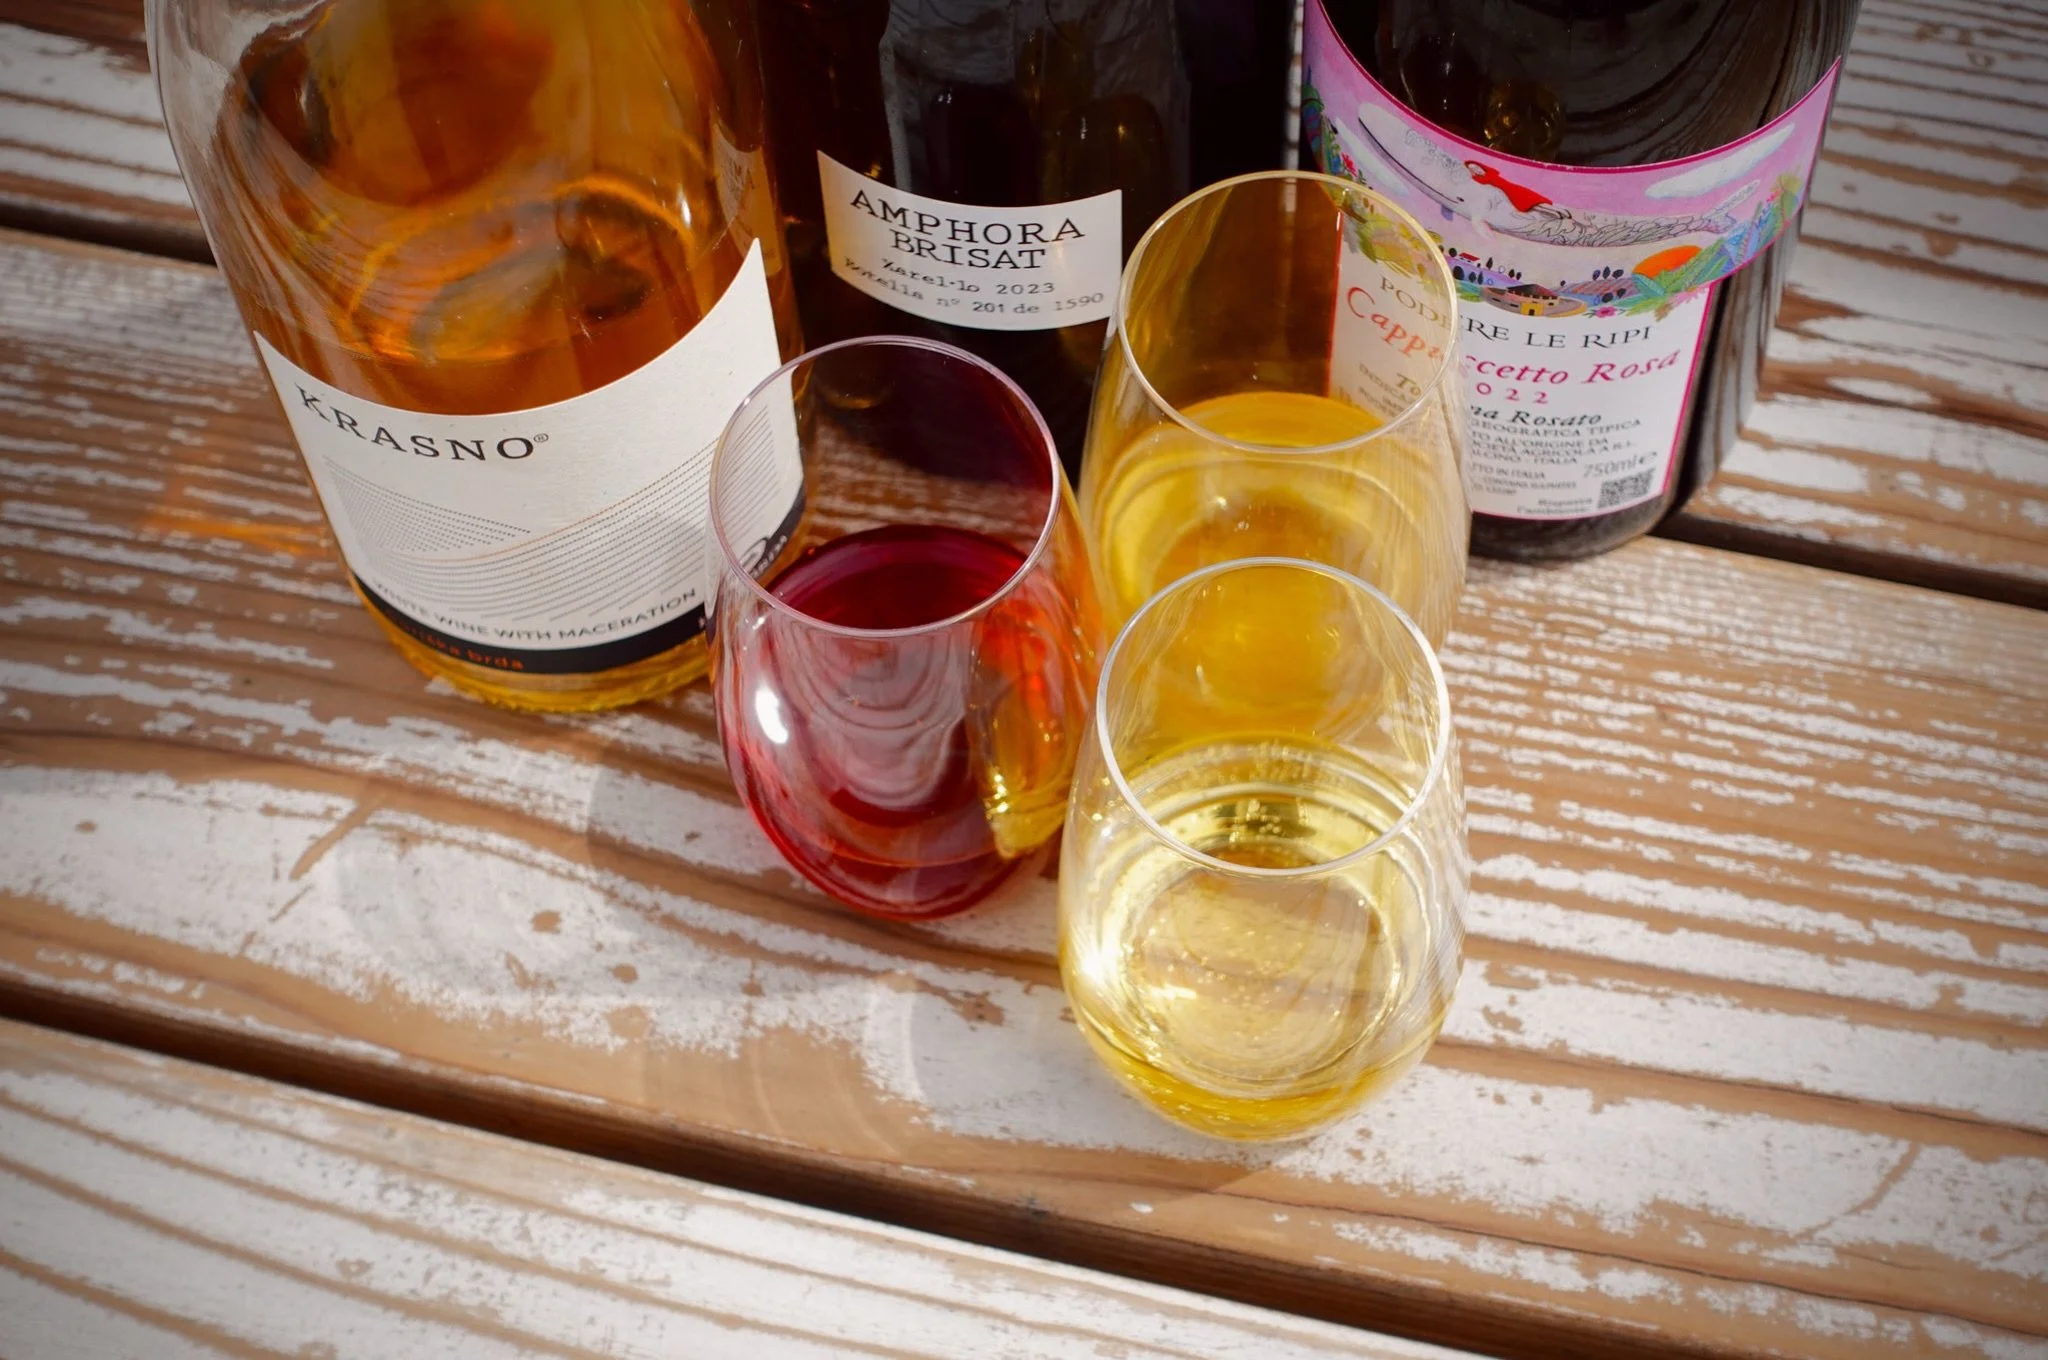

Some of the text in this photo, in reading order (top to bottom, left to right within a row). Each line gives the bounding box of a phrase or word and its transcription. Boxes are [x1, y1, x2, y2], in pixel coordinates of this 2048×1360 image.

[850, 189, 1085, 246] AMPHORA
[890, 229, 1047, 270] BRISAT
[996, 282, 1056, 297] 2023
[1013, 304, 1041, 314] de
[1054, 292, 1105, 313] 1590
[1527, 332, 1566, 350] LE
[1583, 325, 1650, 350] RIPI
[1580, 349, 1682, 385] Rosa
[296, 382, 535, 464] KRASNO
[1511, 410, 1603, 427] Rosato
[1587, 418, 1641, 437] TIPICA
[494, 626, 551, 641] WITH
[557, 588, 696, 641] MACERATION
